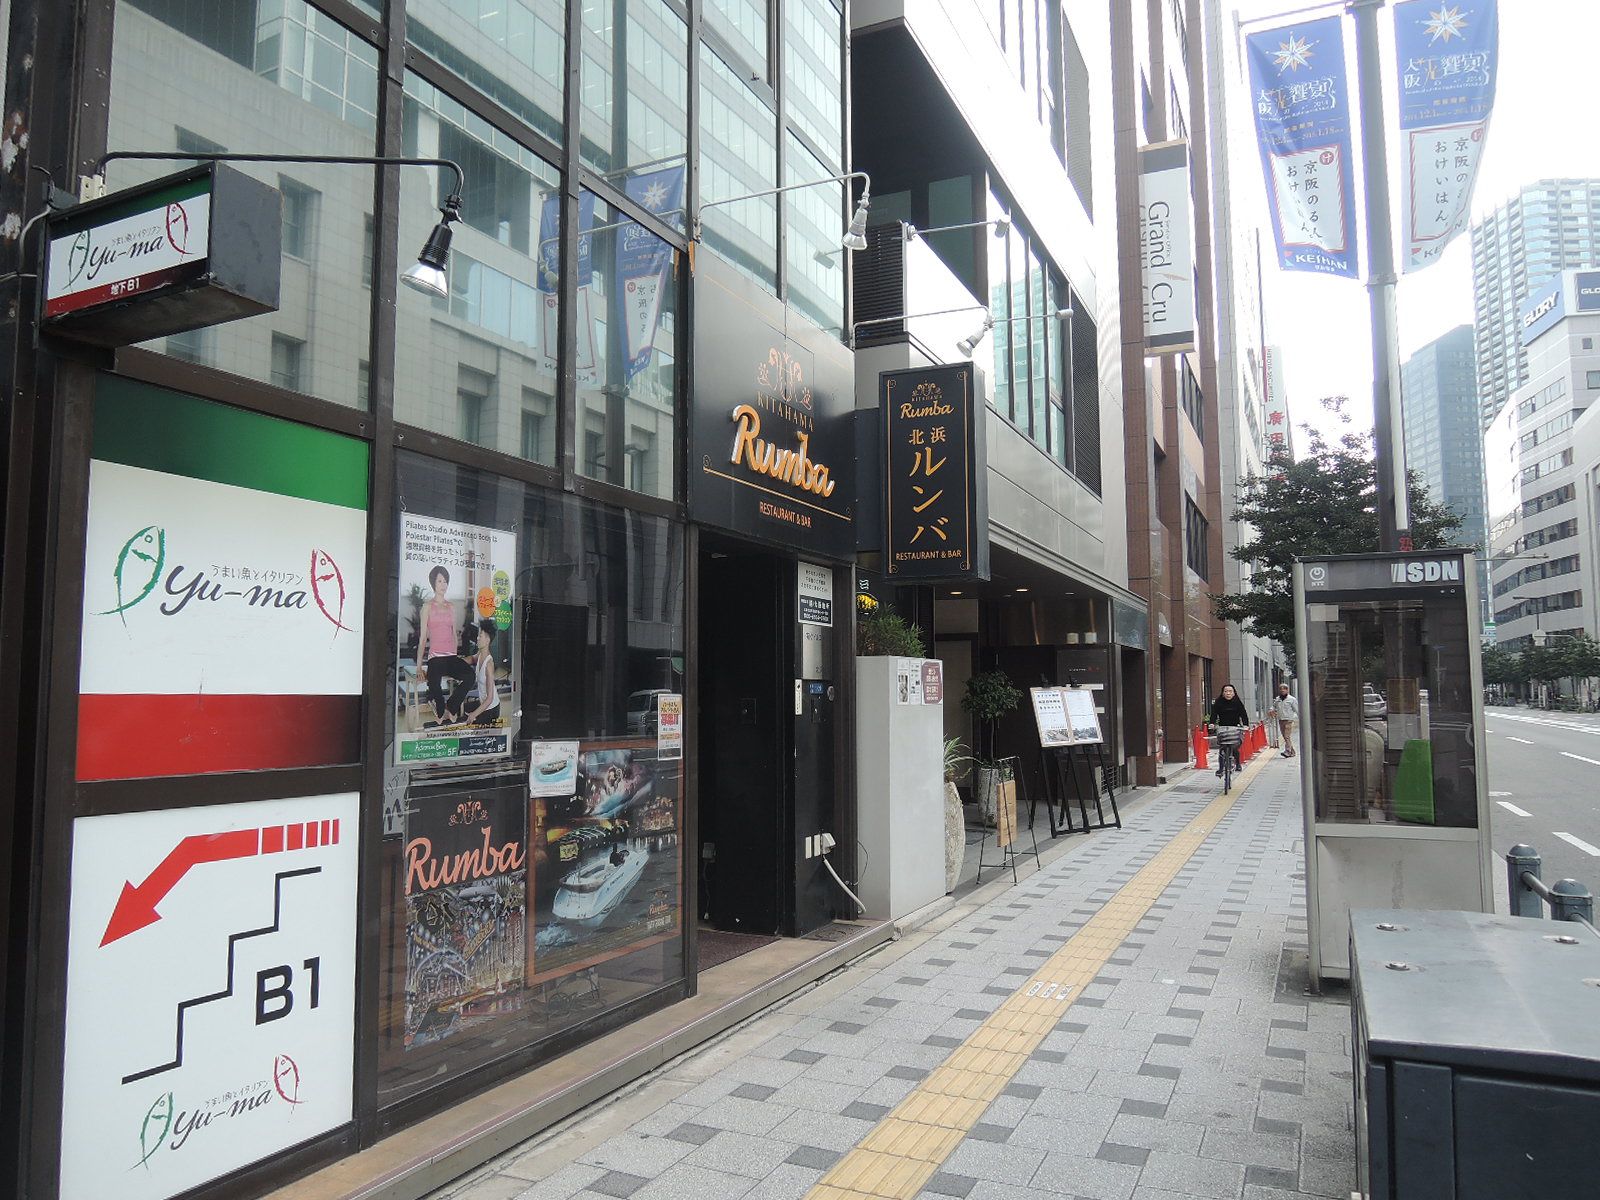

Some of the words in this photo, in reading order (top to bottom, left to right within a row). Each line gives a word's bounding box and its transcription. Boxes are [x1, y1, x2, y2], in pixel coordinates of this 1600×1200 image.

[1149, 201, 1173, 269] Grand
[1295, 254, 1347, 270] KEIHAN
[1151, 282, 1173, 323] Cru
[900, 401, 954, 420] Rumba
[909, 426, 946, 445] 北浜
[731, 404, 836, 498] Rumba
[909, 447, 949, 544] ルンバ
[759, 501, 796, 523] RESTAURANT
[801, 514, 812, 528] BAR
[895, 550, 940, 561] RESTAURANT
[941, 551, 947, 559] &
[947, 549, 963, 559] BAR
[211, 564, 303, 585] うまい魚とイタリアン
[1390, 560, 1459, 583] ISDN
[404, 826, 526, 896] Rumba
[255, 956, 320, 1026] B1
